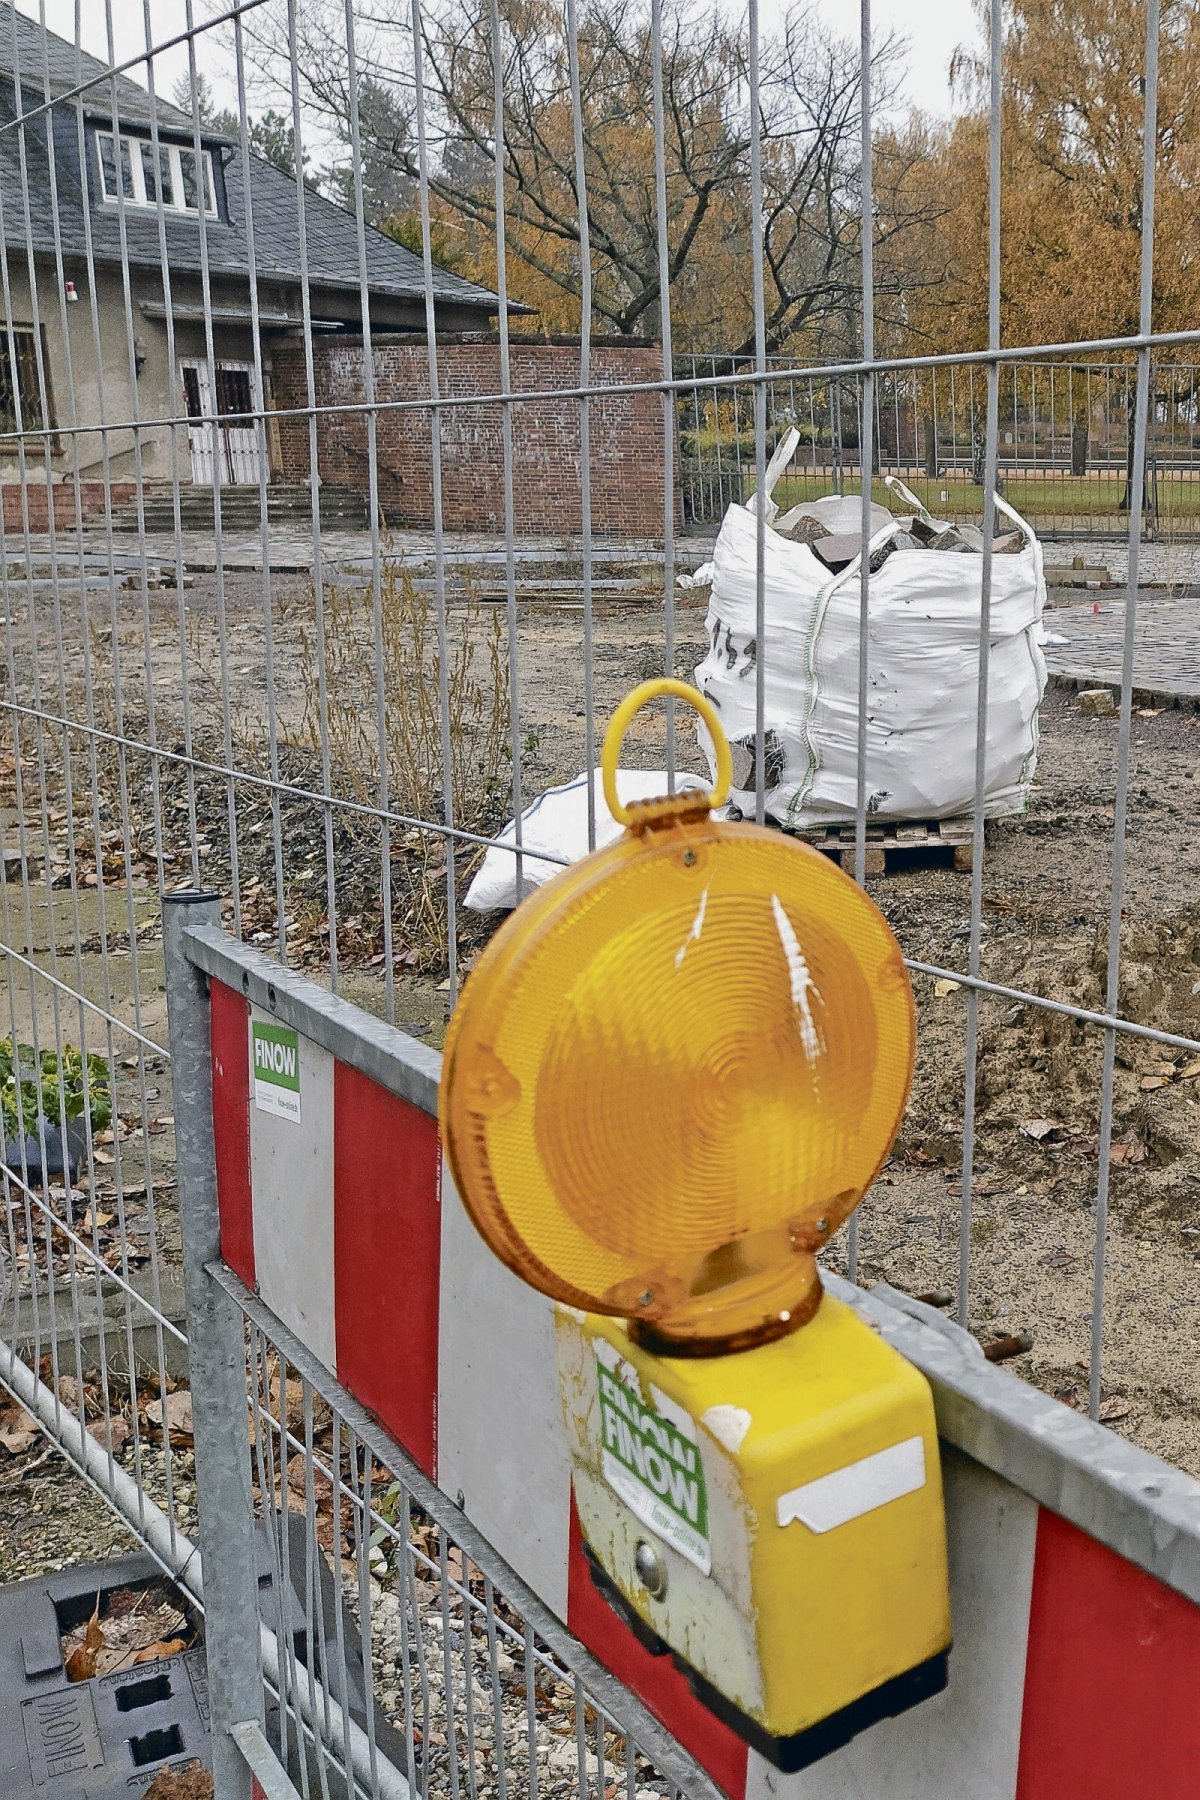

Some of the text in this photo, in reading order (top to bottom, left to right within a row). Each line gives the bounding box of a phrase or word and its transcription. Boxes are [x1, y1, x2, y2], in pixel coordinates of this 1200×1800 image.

[255, 1037, 296, 1078] FINOW
[604, 1402, 699, 1523] FINOW
[37, 1698, 89, 1778] FINOW
